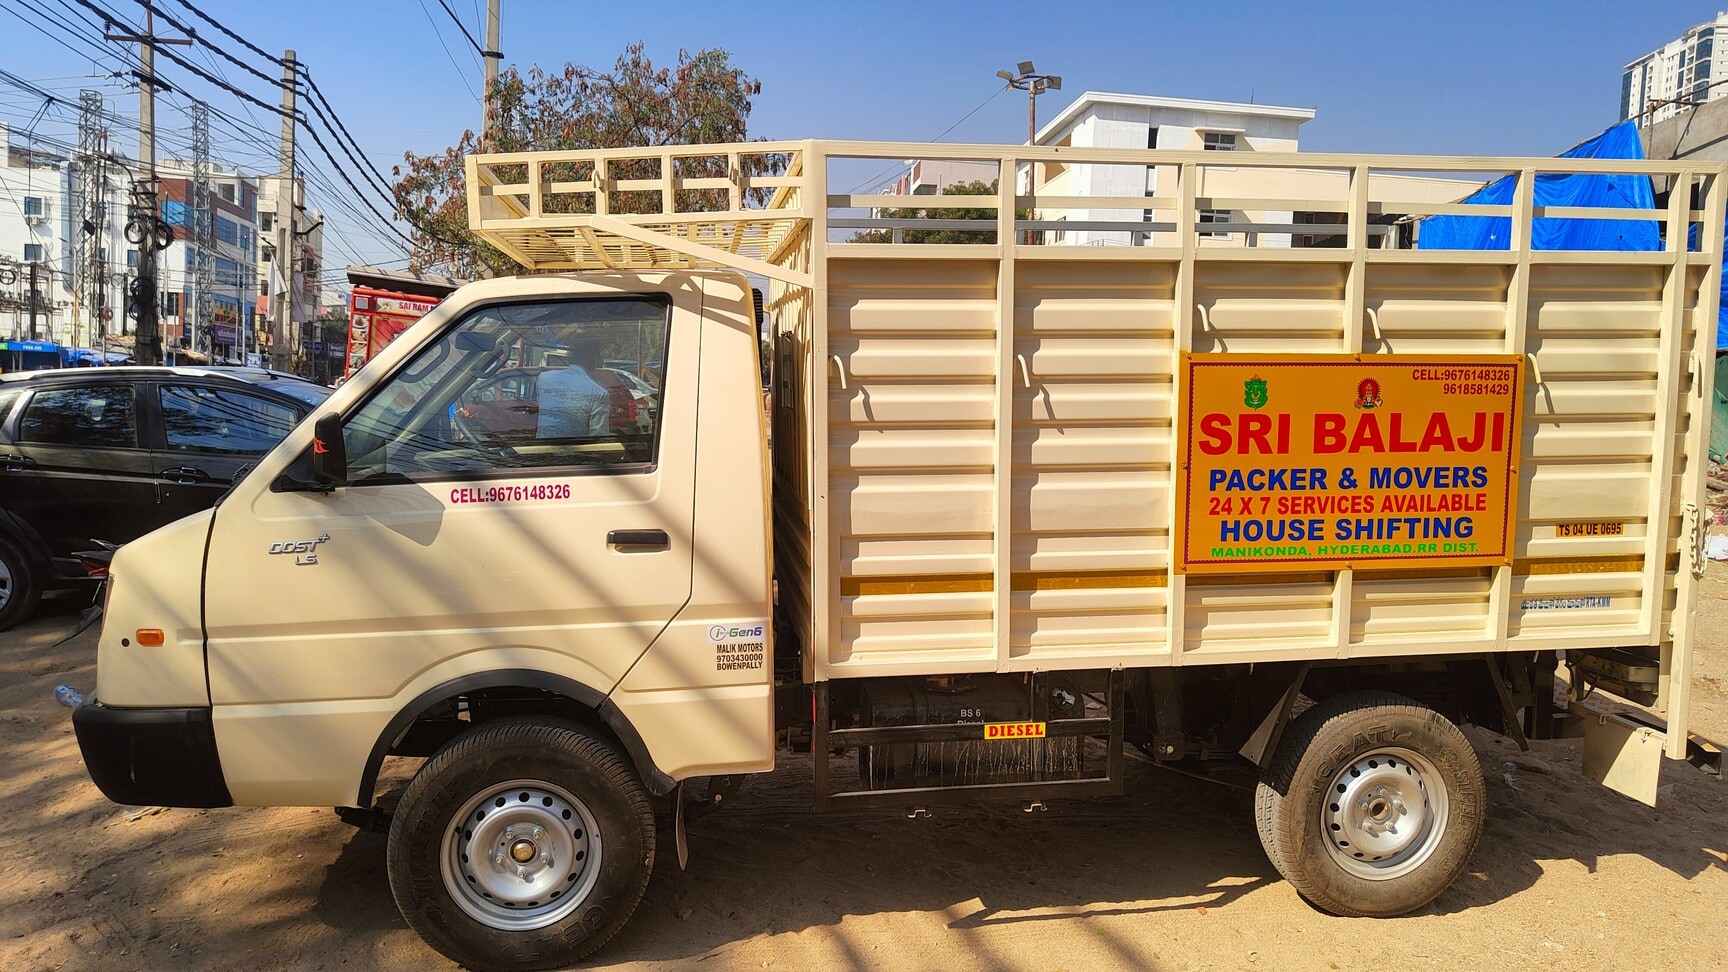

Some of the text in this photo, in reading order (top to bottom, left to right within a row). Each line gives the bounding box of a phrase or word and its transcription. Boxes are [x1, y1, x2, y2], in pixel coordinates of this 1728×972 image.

[399, 302, 410, 310] SAI
[412, 303, 428, 312] RAM
[1412, 369, 1510, 381] CELL:9676148326
[1443, 383, 1509, 395] 9618581429
[1198, 411, 1505, 455] SRI BALAJI
[1209, 465, 1488, 491] PACKER & MOVERS
[451, 484, 571, 503] CELL:9676148326
[1209, 493, 1487, 515] 24 X 7 SERVICES AVAILABLE
[1220, 516, 1474, 542] HOUSE SHIFTING
[1558, 522, 1622, 536] TS 04 UE 0695
[1211, 546, 1312, 558] MANIKONDA,
[1443, 542, 1479, 554] DIST.
[295, 554, 318, 566] LS
[716, 643, 763, 653] MALIK MOTORS
[716, 653, 763, 662] 9703430000
[716, 661, 763, 671] BOWENPALLY
[960, 709, 981, 717] BS 6
[989, 724, 1043, 737] DIESEL
[1316, 723, 1388, 783] CEAT
